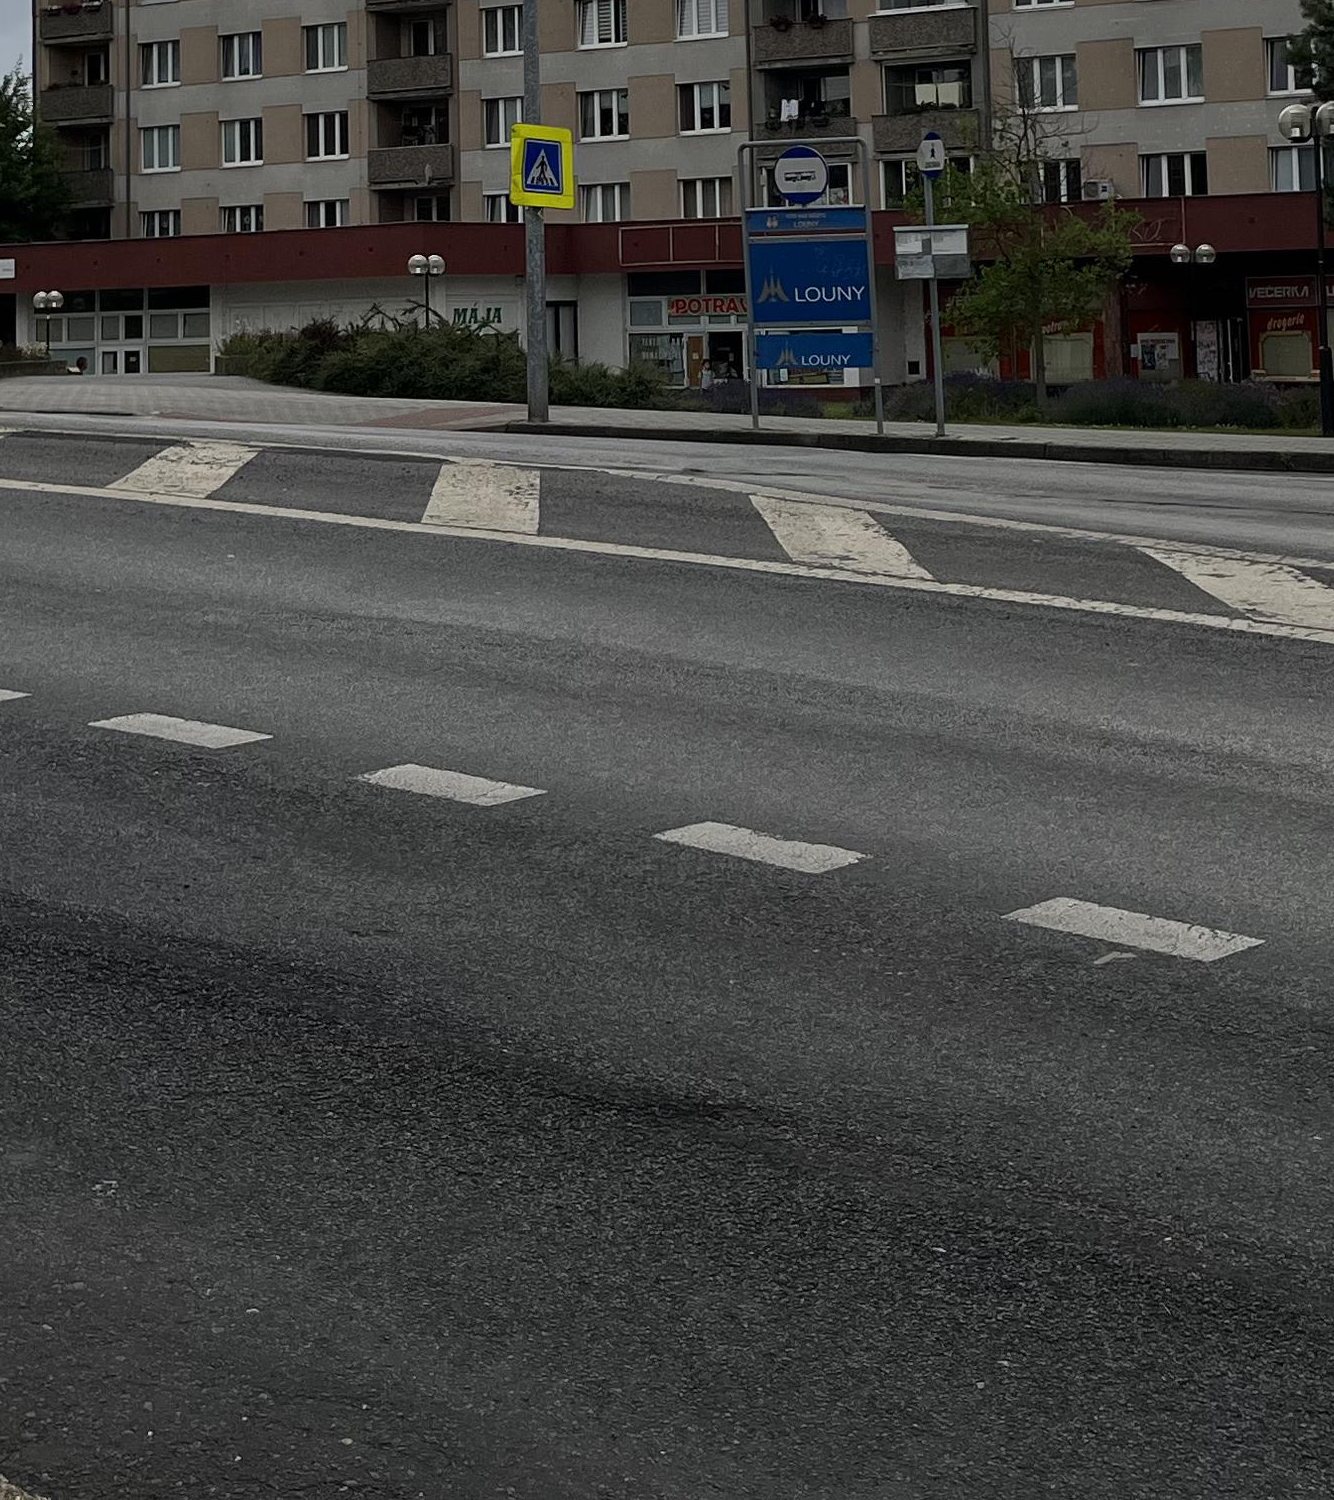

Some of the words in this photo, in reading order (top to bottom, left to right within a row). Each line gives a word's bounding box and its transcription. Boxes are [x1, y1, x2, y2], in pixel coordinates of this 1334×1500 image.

[793, 220, 820, 229] LOUNY
[794, 286, 865, 302] LOUNY
[801, 354, 851, 366] LOUNY
